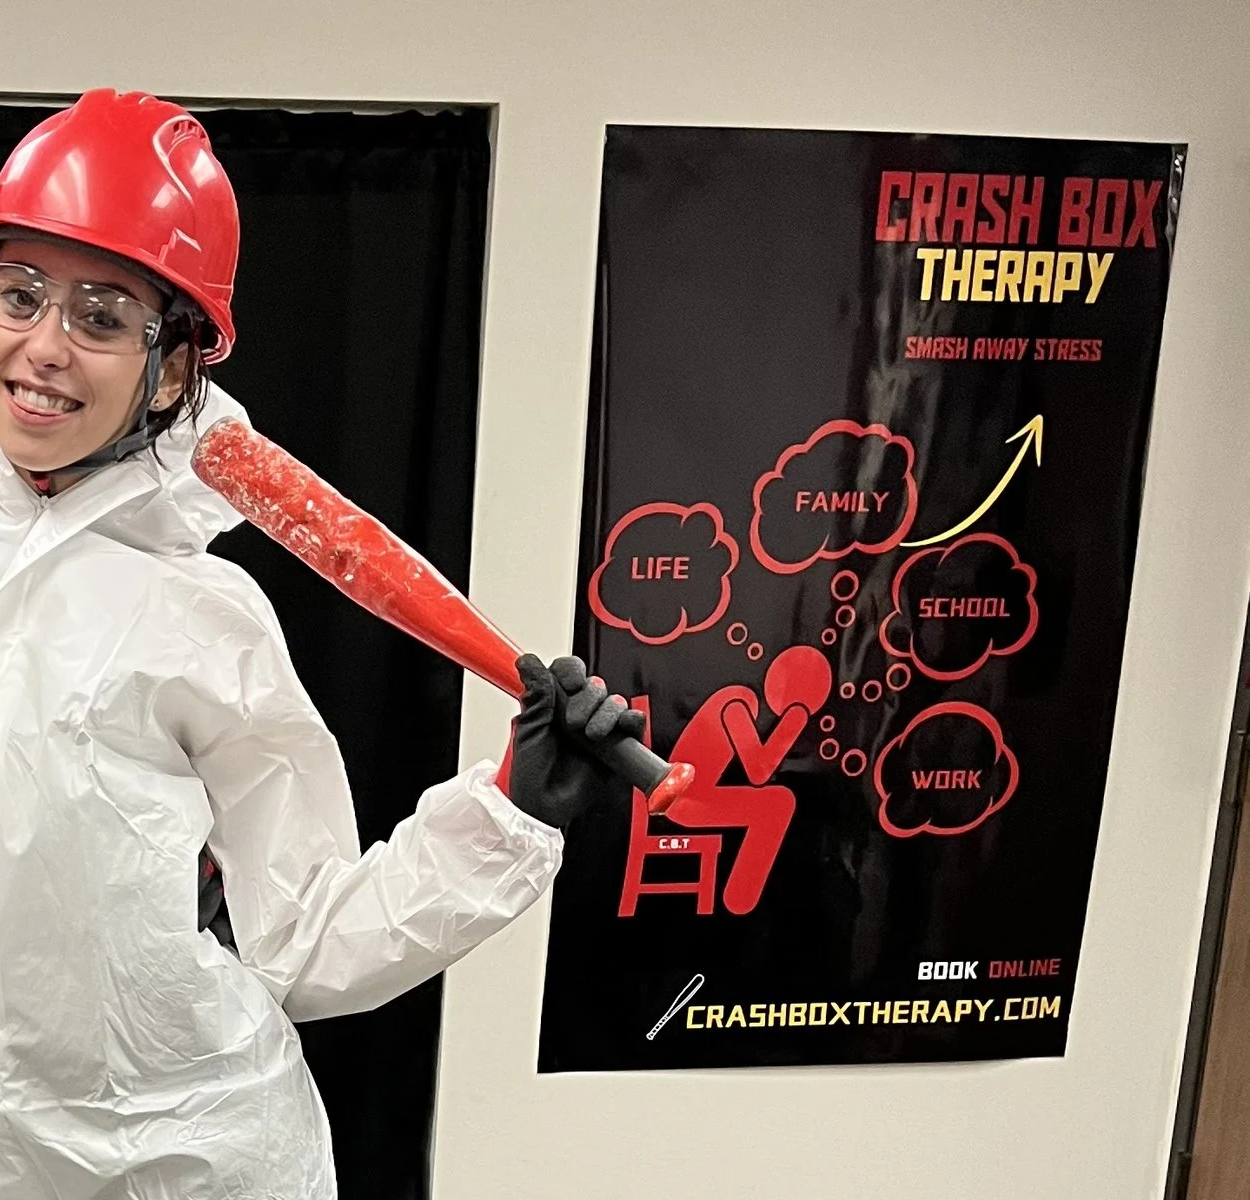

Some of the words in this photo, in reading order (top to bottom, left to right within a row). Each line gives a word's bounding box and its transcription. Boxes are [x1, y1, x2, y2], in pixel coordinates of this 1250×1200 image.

[876, 171, 1045, 244] CRASH
[1058, 177, 1163, 248] BOX
[917, 248, 1114, 304] THERAPY
[905, 336, 968, 359] SMASH
[973, 338, 1030, 360] AWAY
[1034, 338, 1103, 361] STRESS
[796, 491, 890, 513] FAMILY
[631, 556, 691, 580] LIFE
[918, 598, 1010, 618] SCHOOL
[911, 769, 982, 789] WORK
[918, 960, 979, 980] BOOK
[989, 958, 1062, 978] ONLINE
[686, 996, 1061, 1029] CRASHBOXTHERAPY.COM
